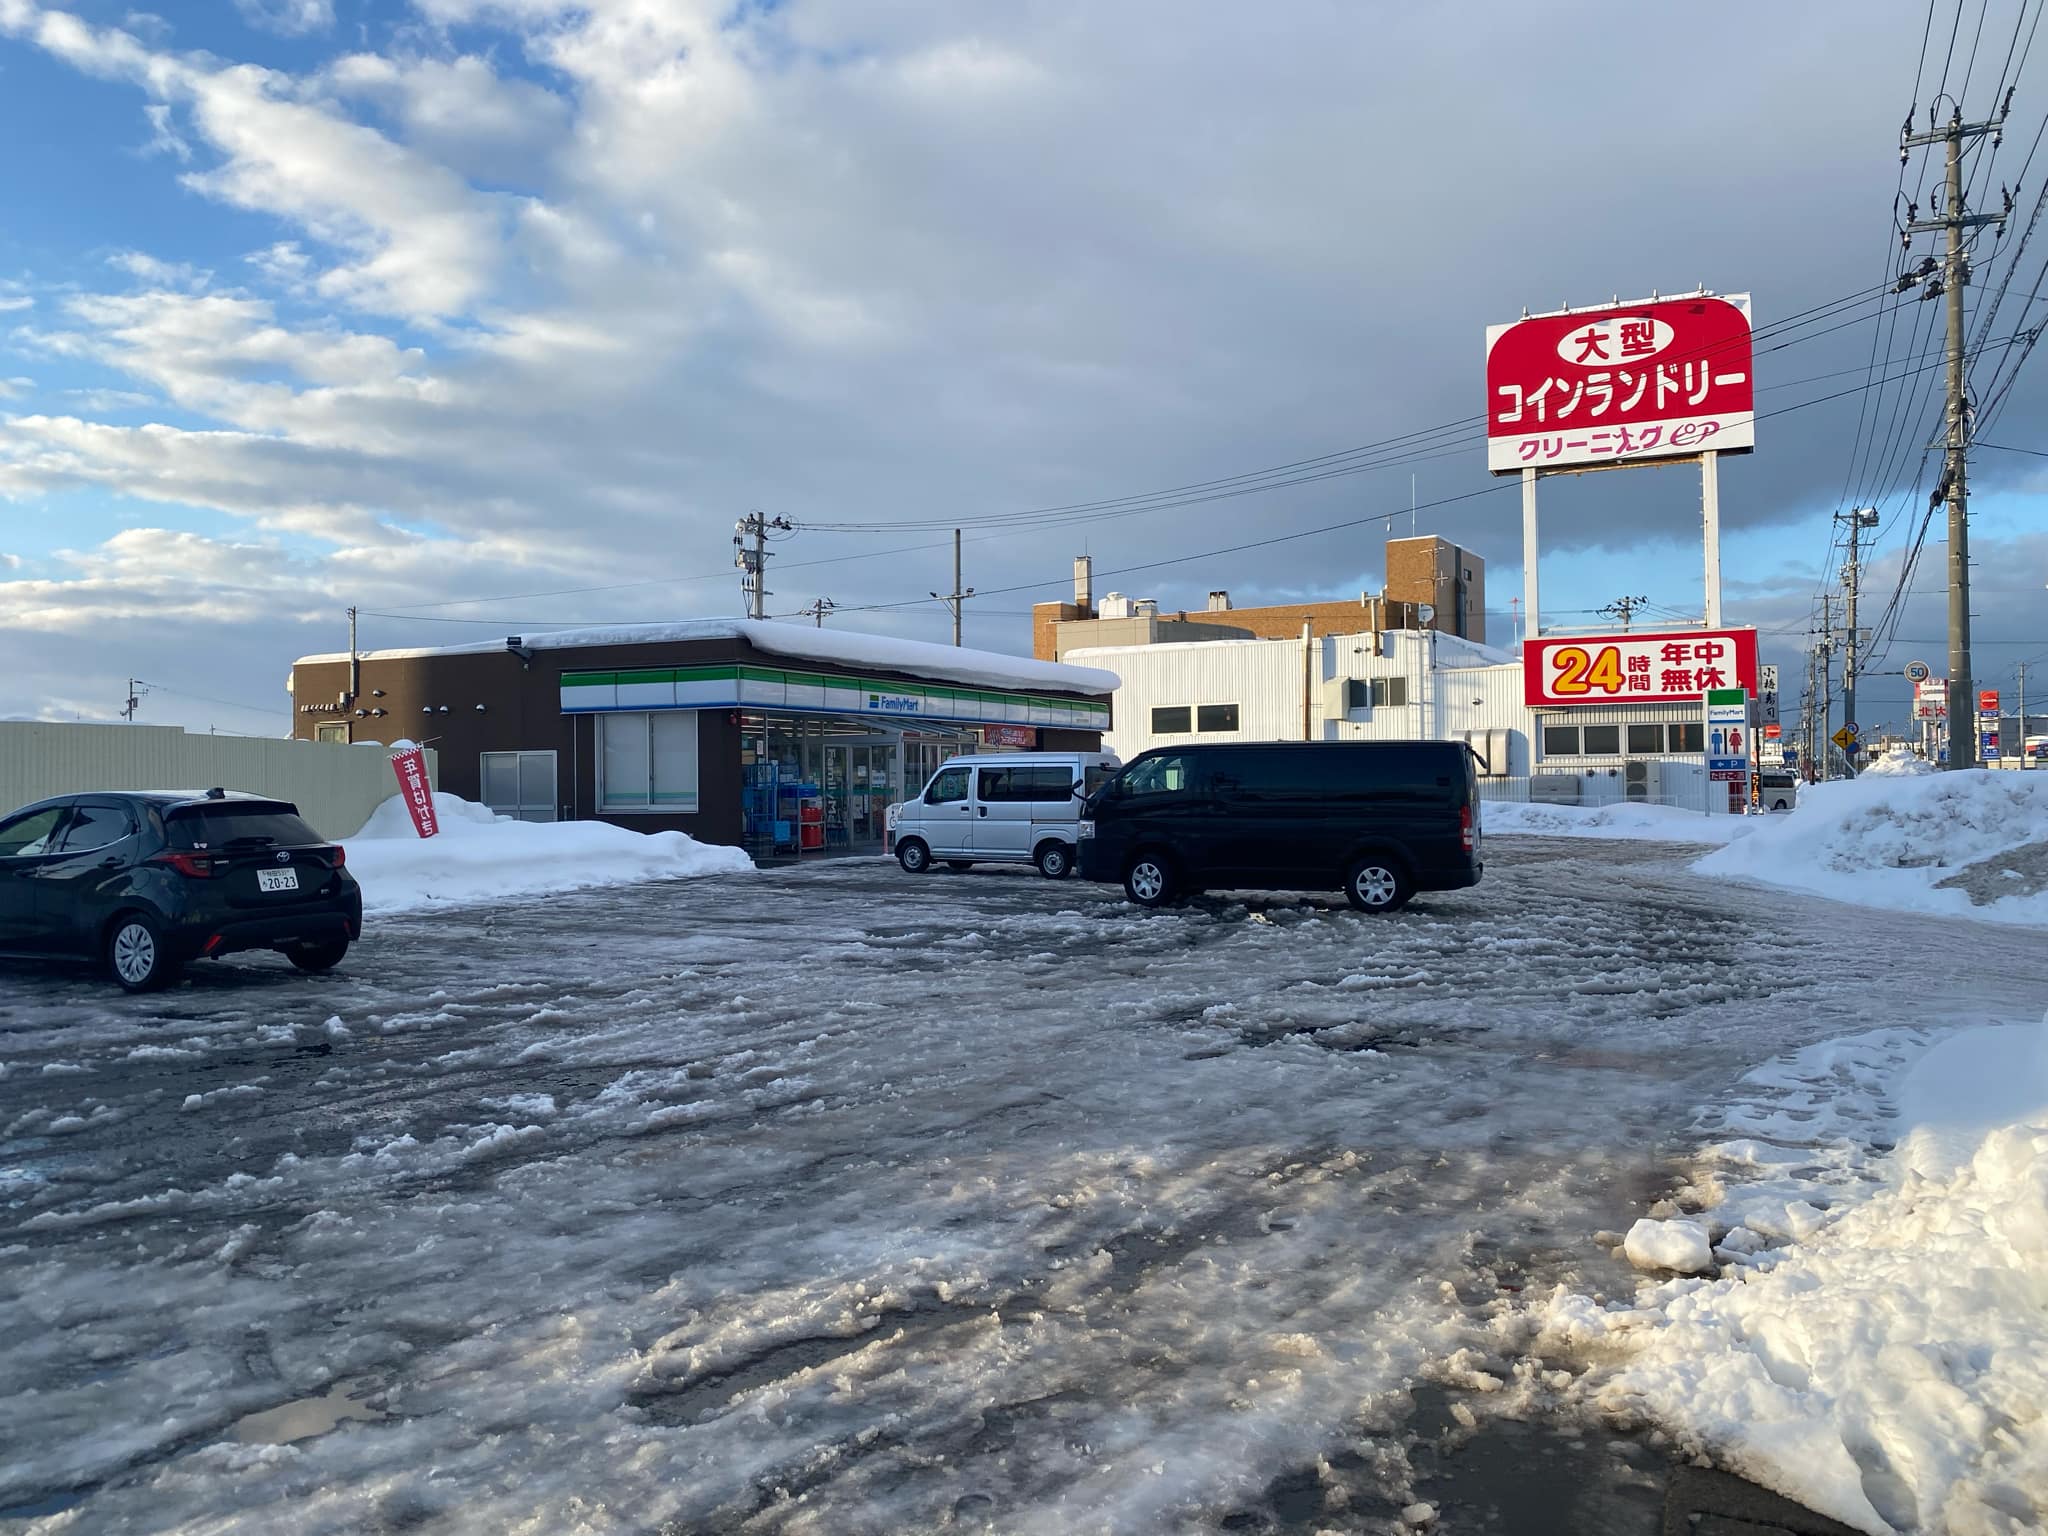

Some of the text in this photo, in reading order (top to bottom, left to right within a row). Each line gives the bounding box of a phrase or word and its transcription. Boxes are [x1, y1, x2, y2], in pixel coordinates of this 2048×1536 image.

[1574, 318, 1657, 364] 大型
[1497, 359, 1746, 424] コインランドリー
[1552, 645, 1627, 696] 24
[1660, 641, 1725, 666] 年中
[1910, 667, 1925, 677] 50
[1660, 667, 1727, 692] 無休
[881, 695, 919, 712] FamilyMart
[1709, 708, 1744, 717] FamilyMart
[1730, 760, 1738, 769] P
[267, 876, 297, 889] 20-23
